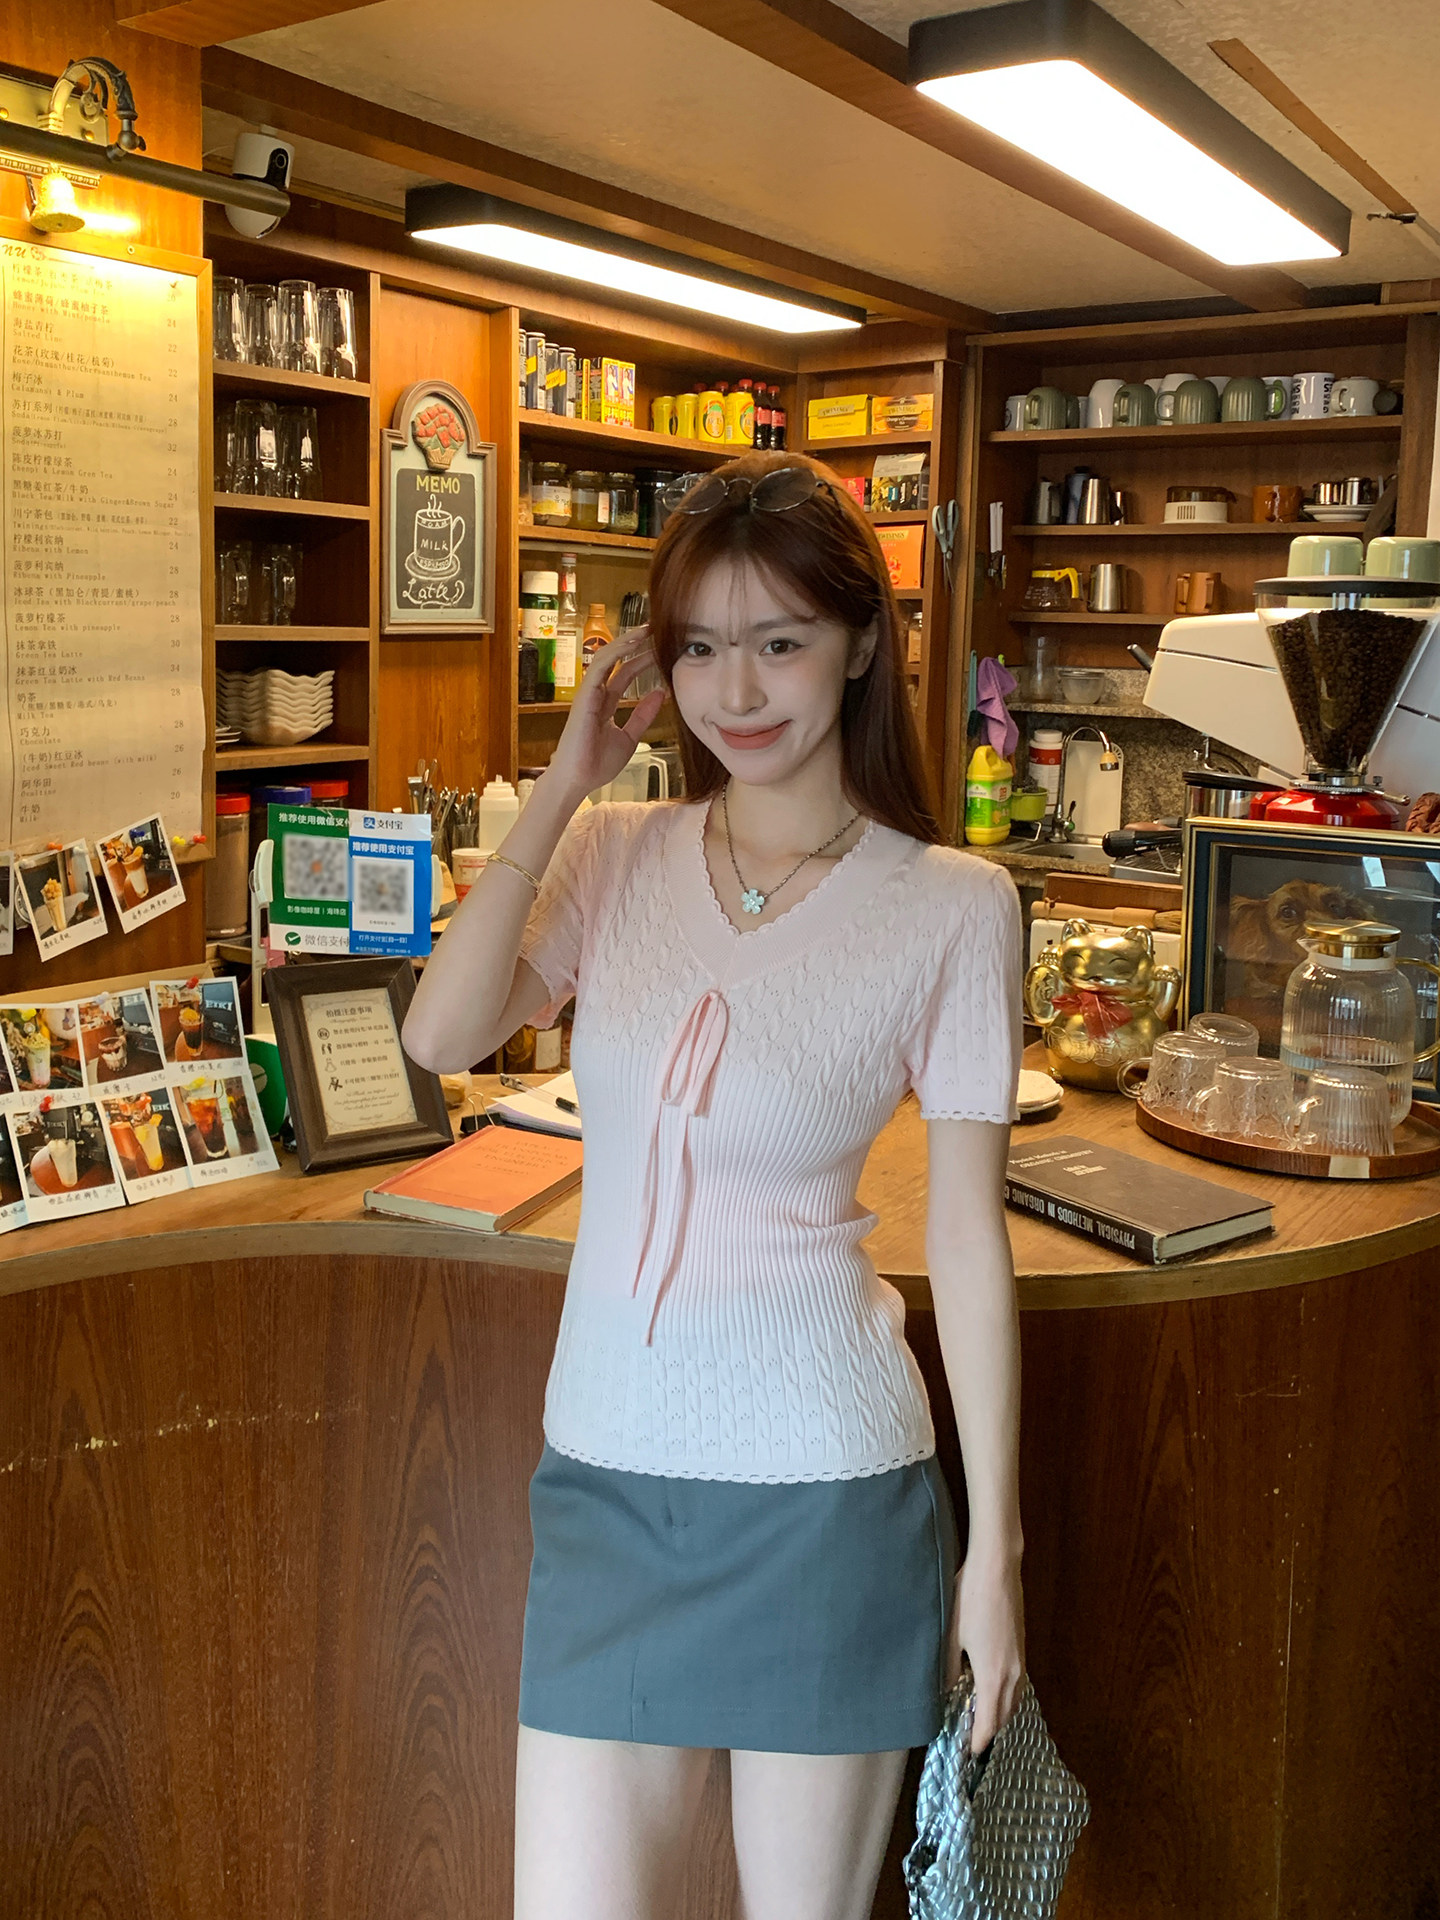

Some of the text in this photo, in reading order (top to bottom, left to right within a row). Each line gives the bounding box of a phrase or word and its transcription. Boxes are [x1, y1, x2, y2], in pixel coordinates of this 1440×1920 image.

[12, 317, 54, 334] 海盐青柠
[168, 343, 178, 353] 22
[12, 371, 43, 386] 梅子冰
[168, 369, 178, 378] 22
[168, 393, 178, 403] 24
[12, 399, 53, 414] 苏打系列
[168, 417, 178, 427] 28
[12, 426, 63, 441] 菠萝冰苏打
[167, 443, 177, 452] 32
[12, 452, 73, 468] 陈皮柠檬绿茶
[167, 468, 177, 477] 24
[13, 479, 89, 496] 黑糖姜红茶/牛奶
[416, 475, 460, 494] MEMO
[168, 492, 178, 502] 24
[13, 507, 53, 521] 川宁茶包
[168, 517, 179, 526] 22
[13, 534, 64, 546] 柠檬利宾纳
[420, 539, 449, 551] MILK
[169, 542, 179, 551] 24
[13, 560, 64, 572] 菠萝利宾纳
[169, 566, 179, 575] 28
[169, 590, 179, 599] 28
[402, 578, 452, 605] Latte
[15, 612, 66, 624] 菠萝柠檬茶
[170, 614, 180, 623] 28
[16, 640, 57, 651] 抹茶拿铁
[170, 640, 180, 648] 30
[16, 665, 78, 677] 抹茶红豆奶冰
[170, 664, 180, 672] 34
[17, 692, 37, 704] 奶茶
[170, 688, 181, 697] 28
[174, 720, 184, 729] 28
[20, 726, 50, 738] 巧克力
[174, 744, 184, 753] 26
[172, 768, 182, 776] 26
[21, 778, 52, 789] 阿华田
[170, 791, 181, 800] 20
[20, 804, 40, 814] 牛奶
[377, 819, 403, 830] 支付宝
[352, 842, 414, 856] 推荐使用支付宝
[205, 1000, 233, 1012] EIKI
[1012, 1188, 1045, 1214] ORGANIC
[1047, 1201, 1056, 1218] IN
[1057, 1206, 1094, 1234] METHODS
[1096, 1220, 1135, 1250] PHYSICAL
